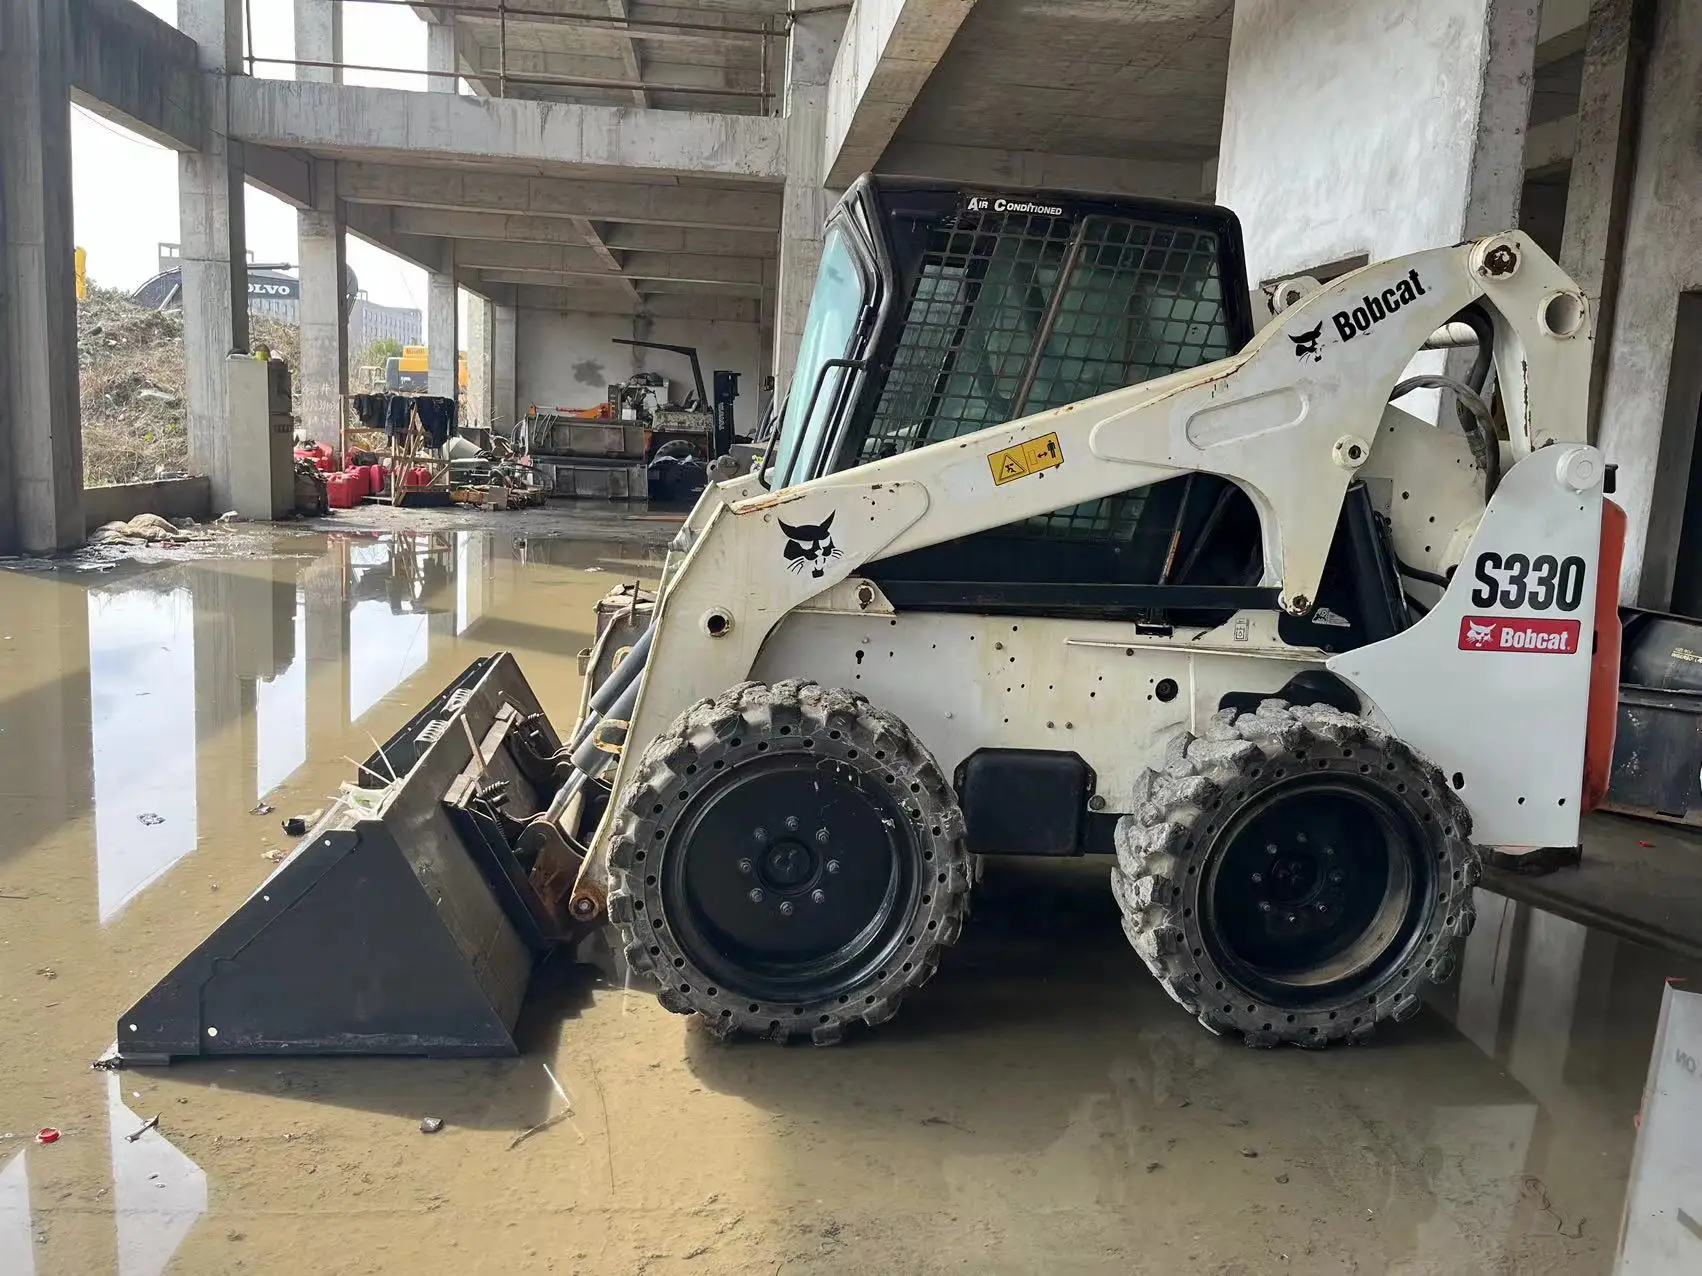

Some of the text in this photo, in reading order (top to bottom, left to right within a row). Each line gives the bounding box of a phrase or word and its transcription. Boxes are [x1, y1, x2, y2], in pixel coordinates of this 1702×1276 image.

[967, 197, 1062, 215] AIR CONDITIONED
[1332, 269, 1425, 342] Bobcat
[1472, 552, 1586, 611] S330
[1500, 628, 1568, 650] Bobcat
